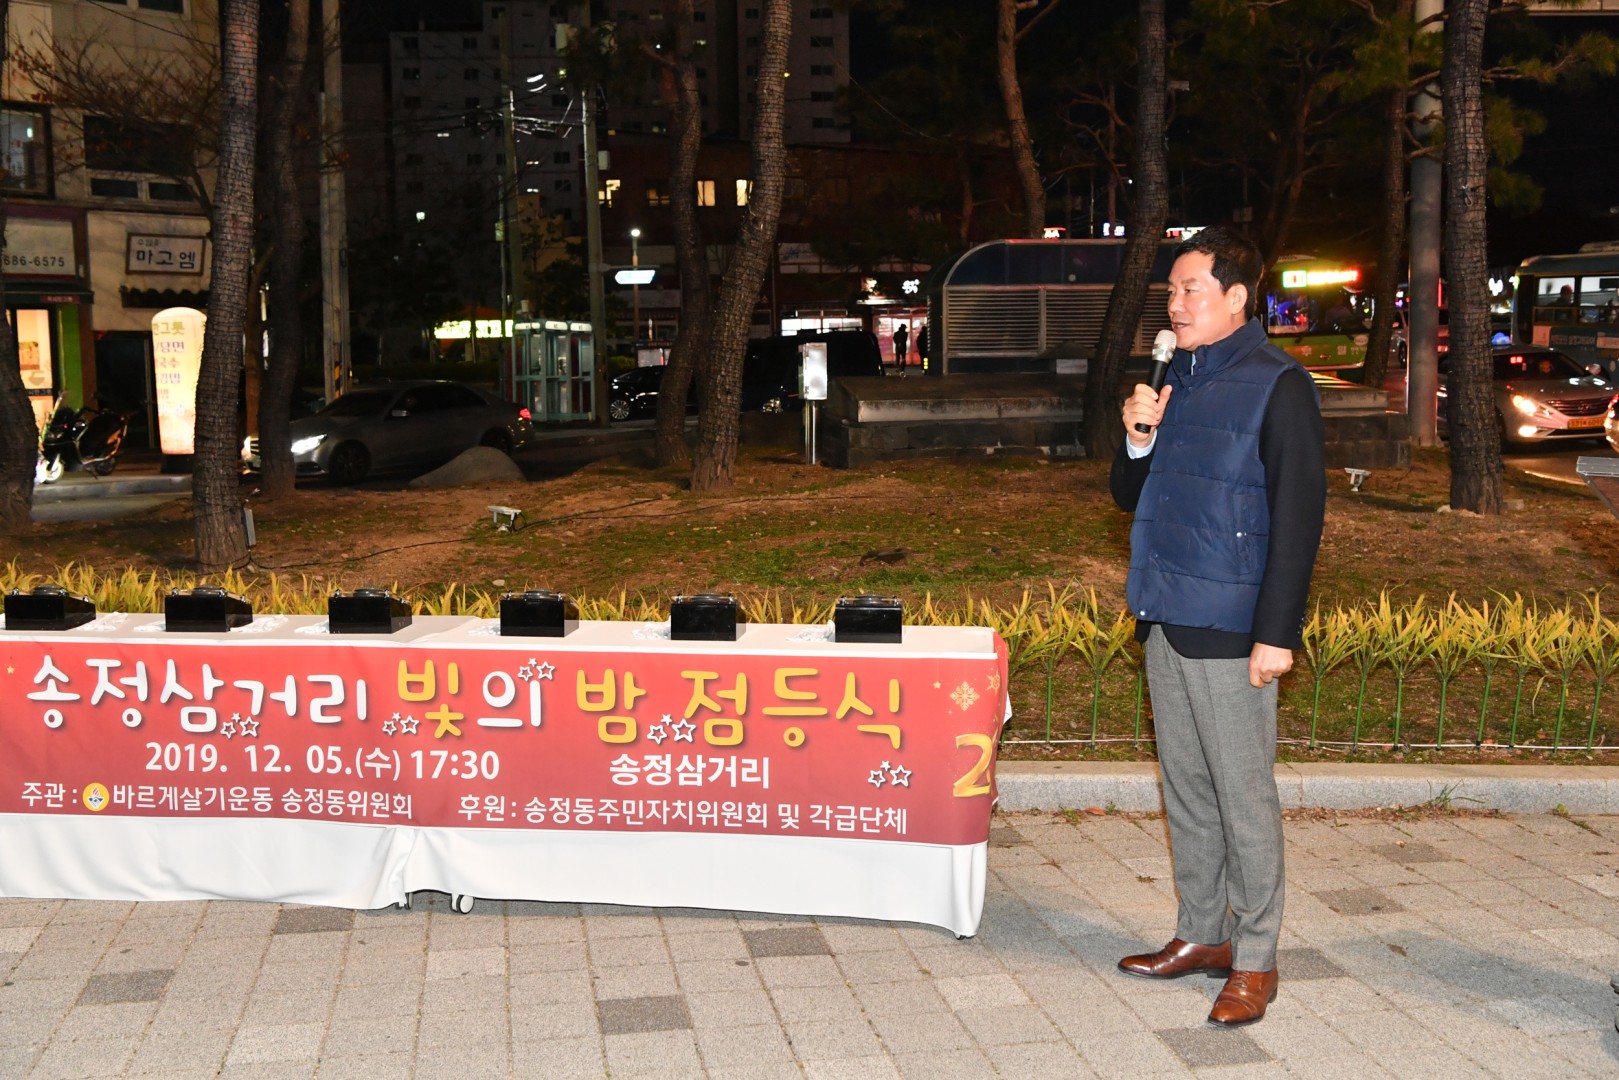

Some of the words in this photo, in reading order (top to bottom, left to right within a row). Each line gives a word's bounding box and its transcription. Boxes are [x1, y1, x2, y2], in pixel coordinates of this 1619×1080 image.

[3, 254, 65, 267] 686-6575
[136, 249, 195, 269] 마고엠
[27, 655, 367, 738] 송정삼거리
[576, 670, 647, 745] 밤
[683, 667, 902, 751] 점등식
[146, 742, 228, 773] 2019.
[244, 745, 292, 773] 12.
[306, 745, 401, 781] 05.(수)
[411, 750, 500, 780] 17:30
[610, 753, 771, 789] 송정삼거리
[113, 784, 274, 813] 바르게살기운동
[281, 787, 413, 821] 송정동위원회
[524, 797, 768, 828] 송정동주민자치위원회
[778, 804, 800, 827] 및
[809, 805, 908, 834] 각급단체
